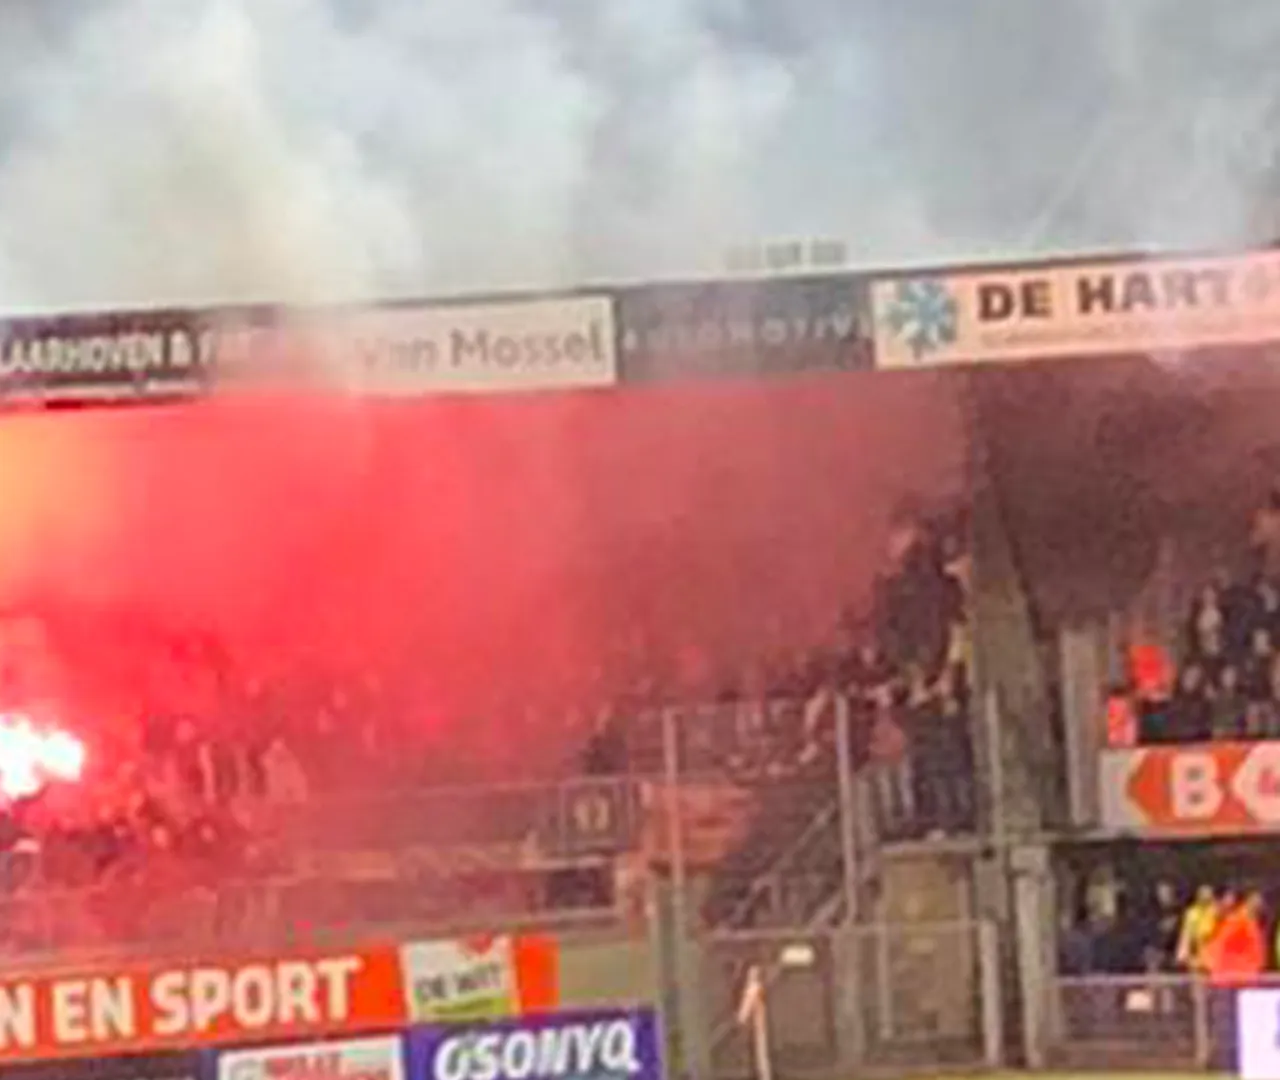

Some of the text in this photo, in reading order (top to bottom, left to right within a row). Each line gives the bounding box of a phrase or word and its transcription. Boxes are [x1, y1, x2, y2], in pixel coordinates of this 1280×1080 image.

[977, 278, 1052, 322] DE
[449, 317, 603, 369] Mossel
[51, 976, 137, 1044] EN
[151, 956, 364, 1035] SPORT
